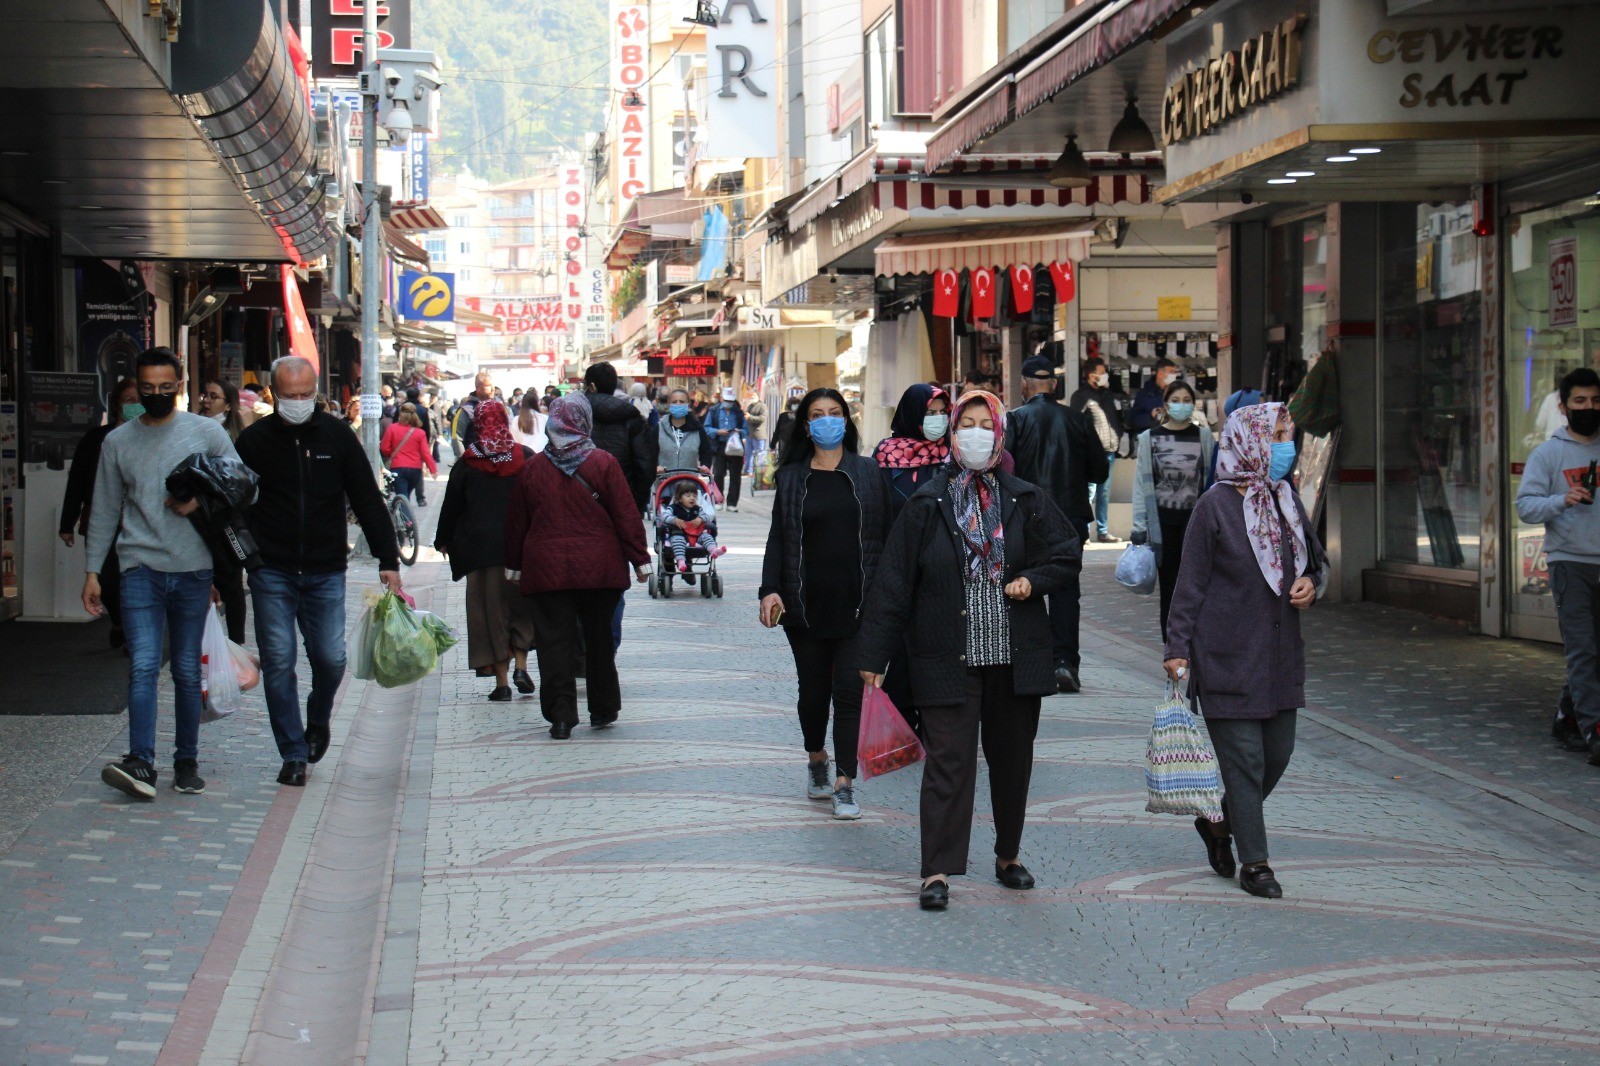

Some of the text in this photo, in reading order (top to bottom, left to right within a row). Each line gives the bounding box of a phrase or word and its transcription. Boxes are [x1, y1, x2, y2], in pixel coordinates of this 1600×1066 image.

[1367, 25, 1563, 64] CEVHER
[1161, 14, 1308, 146] CEVHER SAAT
[1399, 69, 1528, 108] SAAT
